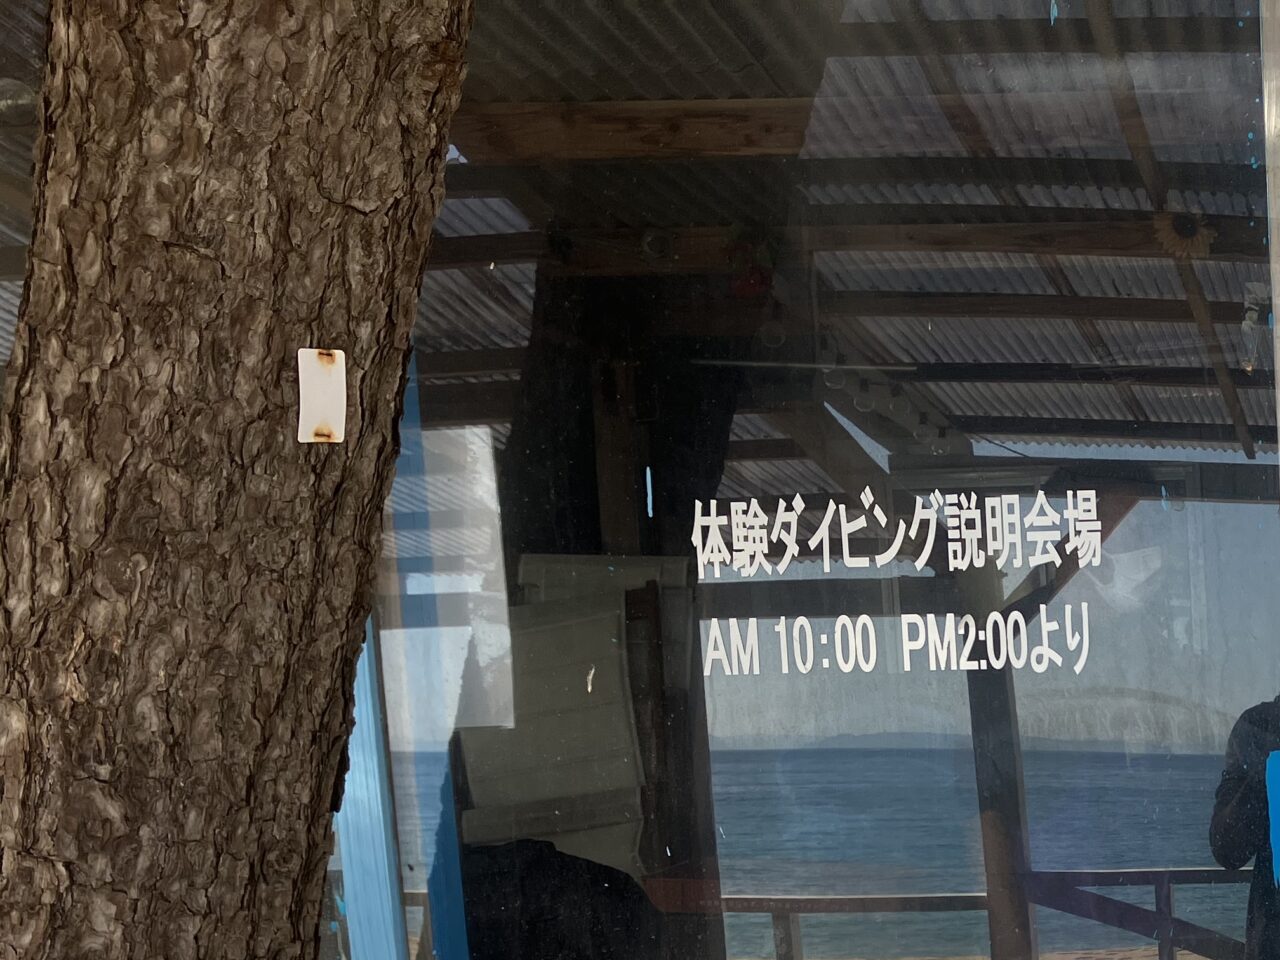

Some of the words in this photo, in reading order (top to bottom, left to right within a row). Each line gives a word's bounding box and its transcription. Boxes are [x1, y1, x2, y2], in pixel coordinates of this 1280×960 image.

[691, 485, 1102, 578] 体験ダイビング説明会場
[703, 617, 760, 676] AM
[774, 614, 877, 674] 10:00
